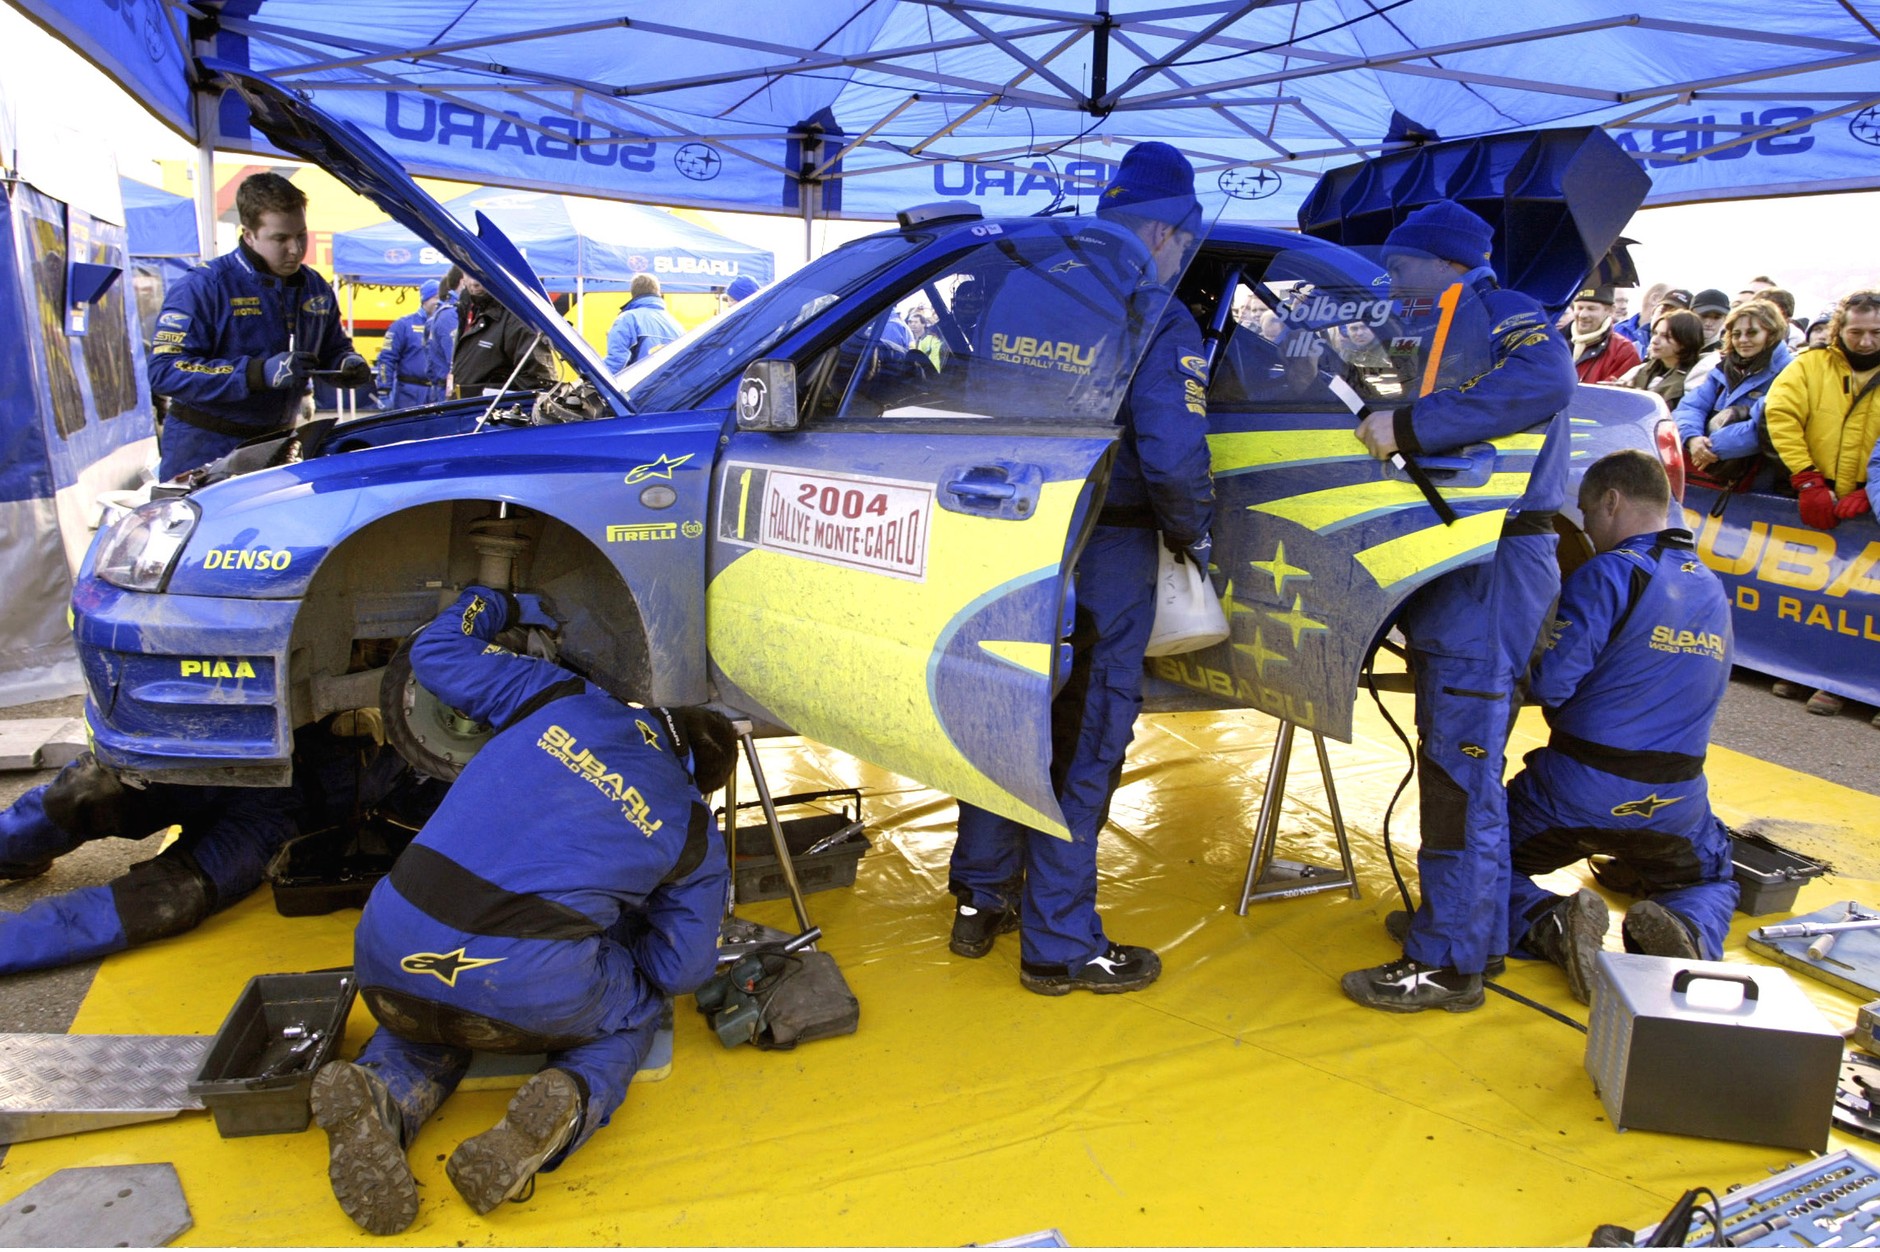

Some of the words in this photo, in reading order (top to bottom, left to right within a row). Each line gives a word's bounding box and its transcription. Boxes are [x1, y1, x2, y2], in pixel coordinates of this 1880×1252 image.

[654, 256, 738, 277] SUBARU
[1276, 296, 1394, 328] Solberg
[992, 333, 1096, 366] SUBARU
[1023, 357, 1054, 369] RALLY
[1056, 361, 1091, 375] TEAM
[737, 469, 752, 540] 1
[769, 487, 811, 546] RALLYE
[797, 483, 888, 520] 2004
[606, 522, 677, 543] PIRELLI
[203, 549, 292, 571] DENSO
[180, 660, 256, 678] PIAA
[536, 738, 581, 775] WORLD
[580, 770, 621, 803] RALLY
[620, 803, 654, 838] TEAM
[542, 724, 663, 831] SUBARU
